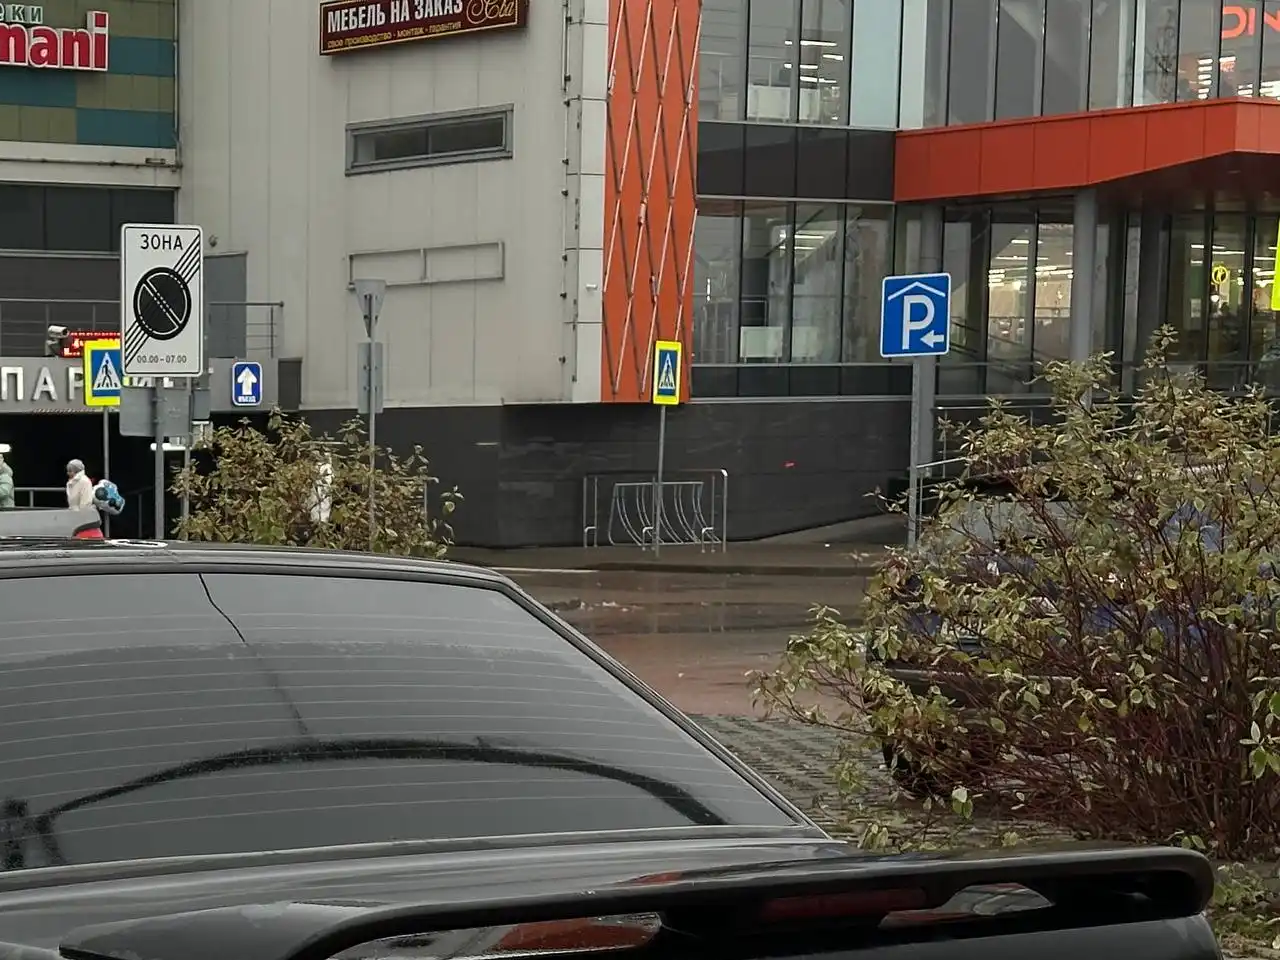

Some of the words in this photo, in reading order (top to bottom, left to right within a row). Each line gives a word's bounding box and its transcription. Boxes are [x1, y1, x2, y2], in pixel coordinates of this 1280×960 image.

[327, 3, 386, 34] МЕБЕЛЬ
[390, 0, 410, 23] НА
[140, 233, 184, 250] ЗОНА
[902, 294, 935, 350] P
